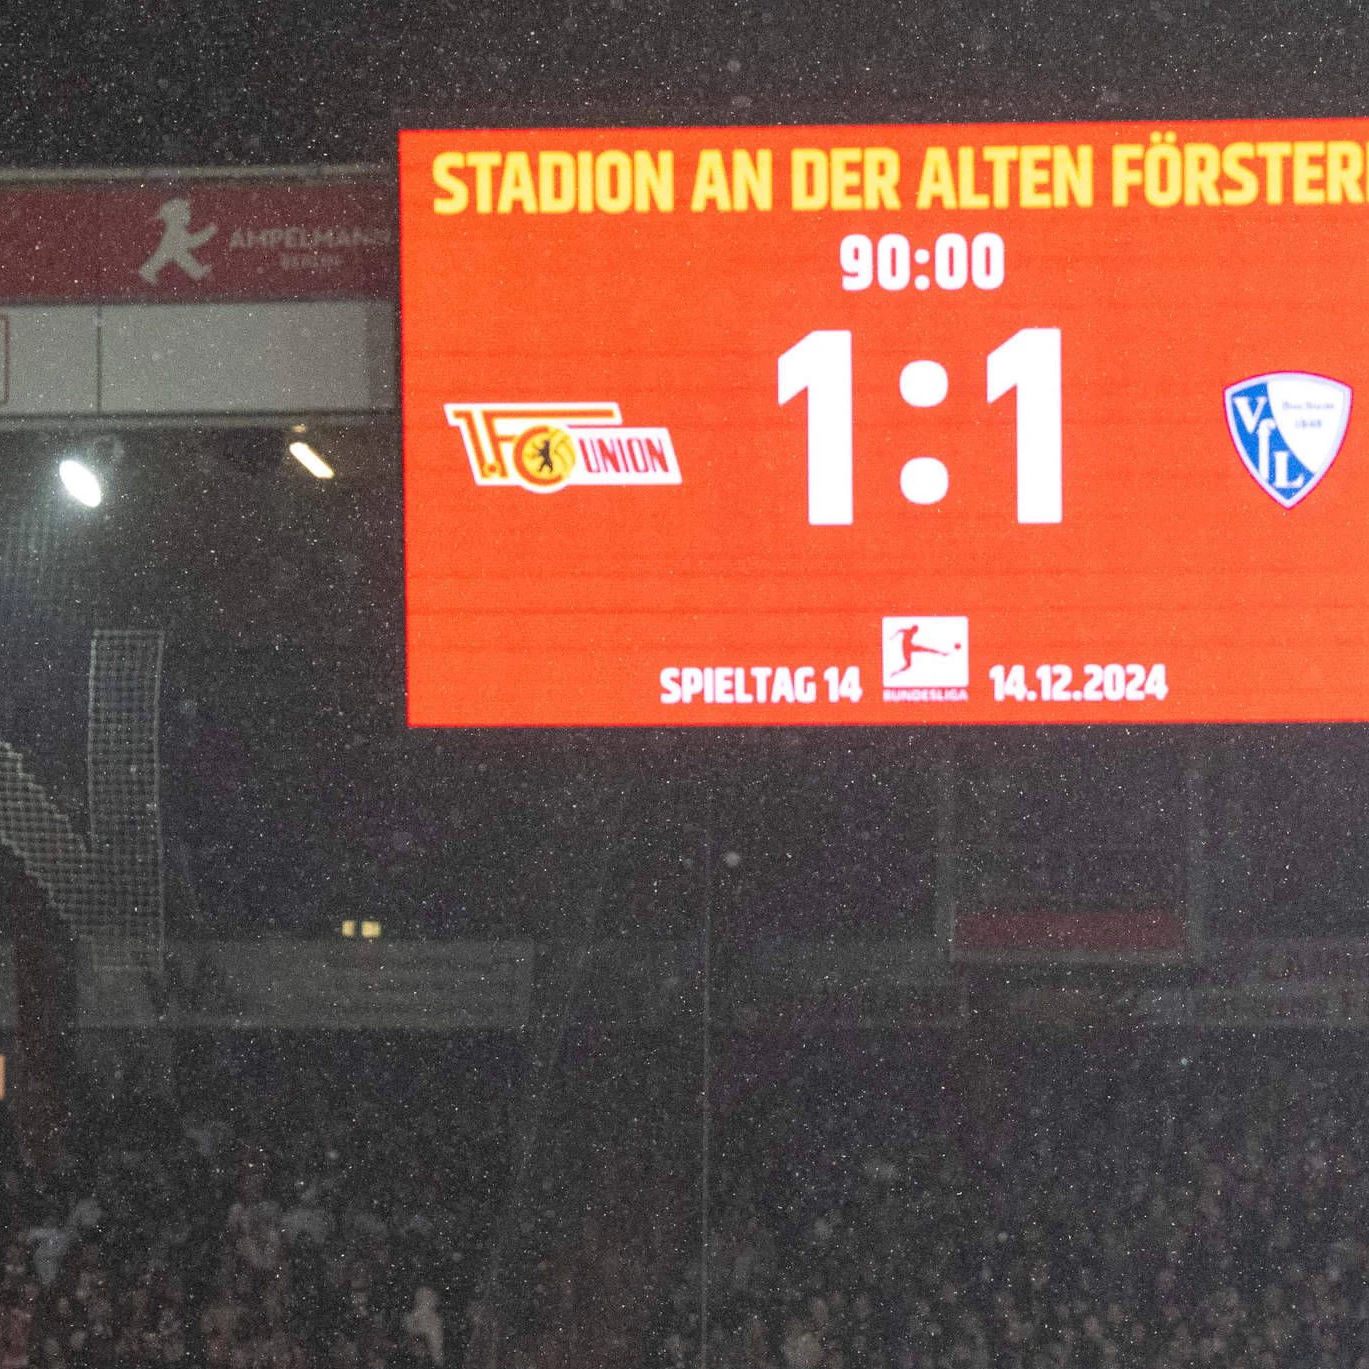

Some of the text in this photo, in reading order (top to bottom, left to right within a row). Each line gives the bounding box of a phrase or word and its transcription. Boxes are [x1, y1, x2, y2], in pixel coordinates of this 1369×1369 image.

[432, 149, 673, 214] STADION
[691, 148, 771, 213] AN
[792, 146, 898, 212] DER
[916, 143, 1094, 210] ALTEN
[840, 233, 1005, 291] 90:00
[578, 437, 670, 474] UNION
[659, 665, 863, 704] SPIELTAG 14
[882, 689, 969, 702] BUNDESLIGA
[989, 663, 1169, 702] 14.12.2024
